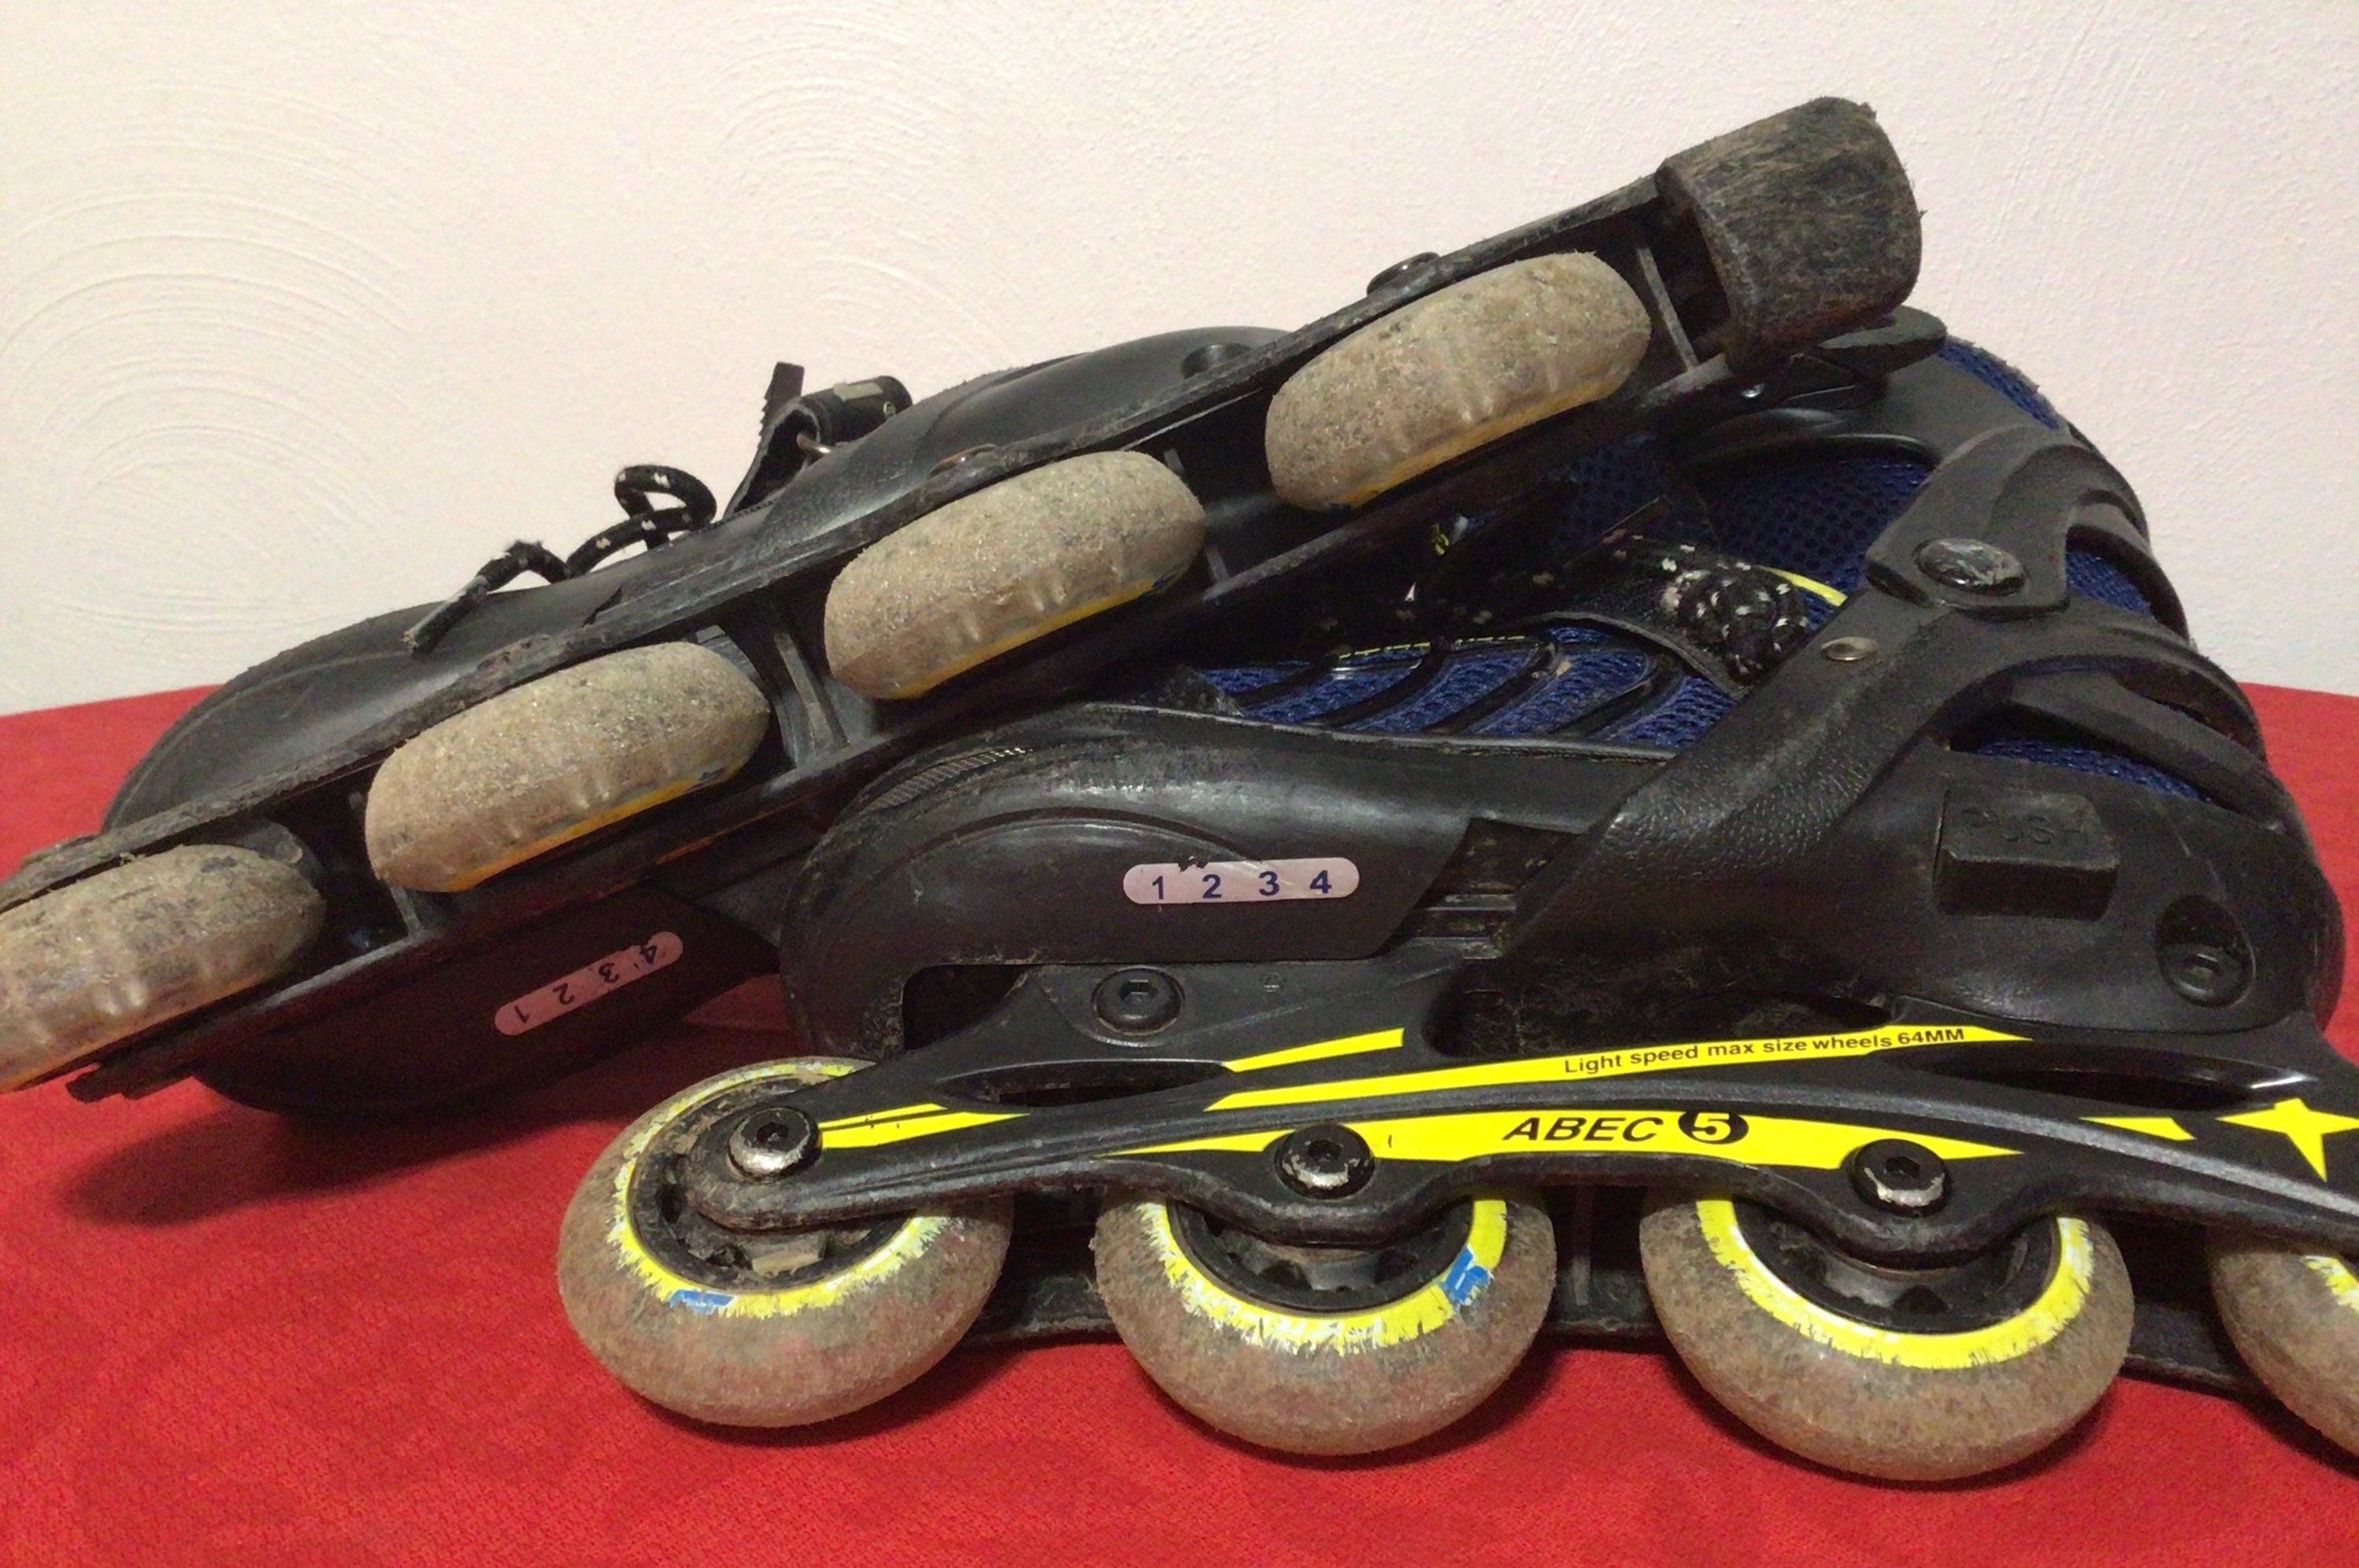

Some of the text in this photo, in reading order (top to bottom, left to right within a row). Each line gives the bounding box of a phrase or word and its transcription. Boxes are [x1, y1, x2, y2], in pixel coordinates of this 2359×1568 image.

[1151, 870, 1332, 900] 1 2 3 4
[513, 945, 658, 1024] 4 3 2 1
[1565, 1028, 1965, 1074] Light speed max size wheels 64MM
[1502, 1111, 1733, 1142] ABEC 5
